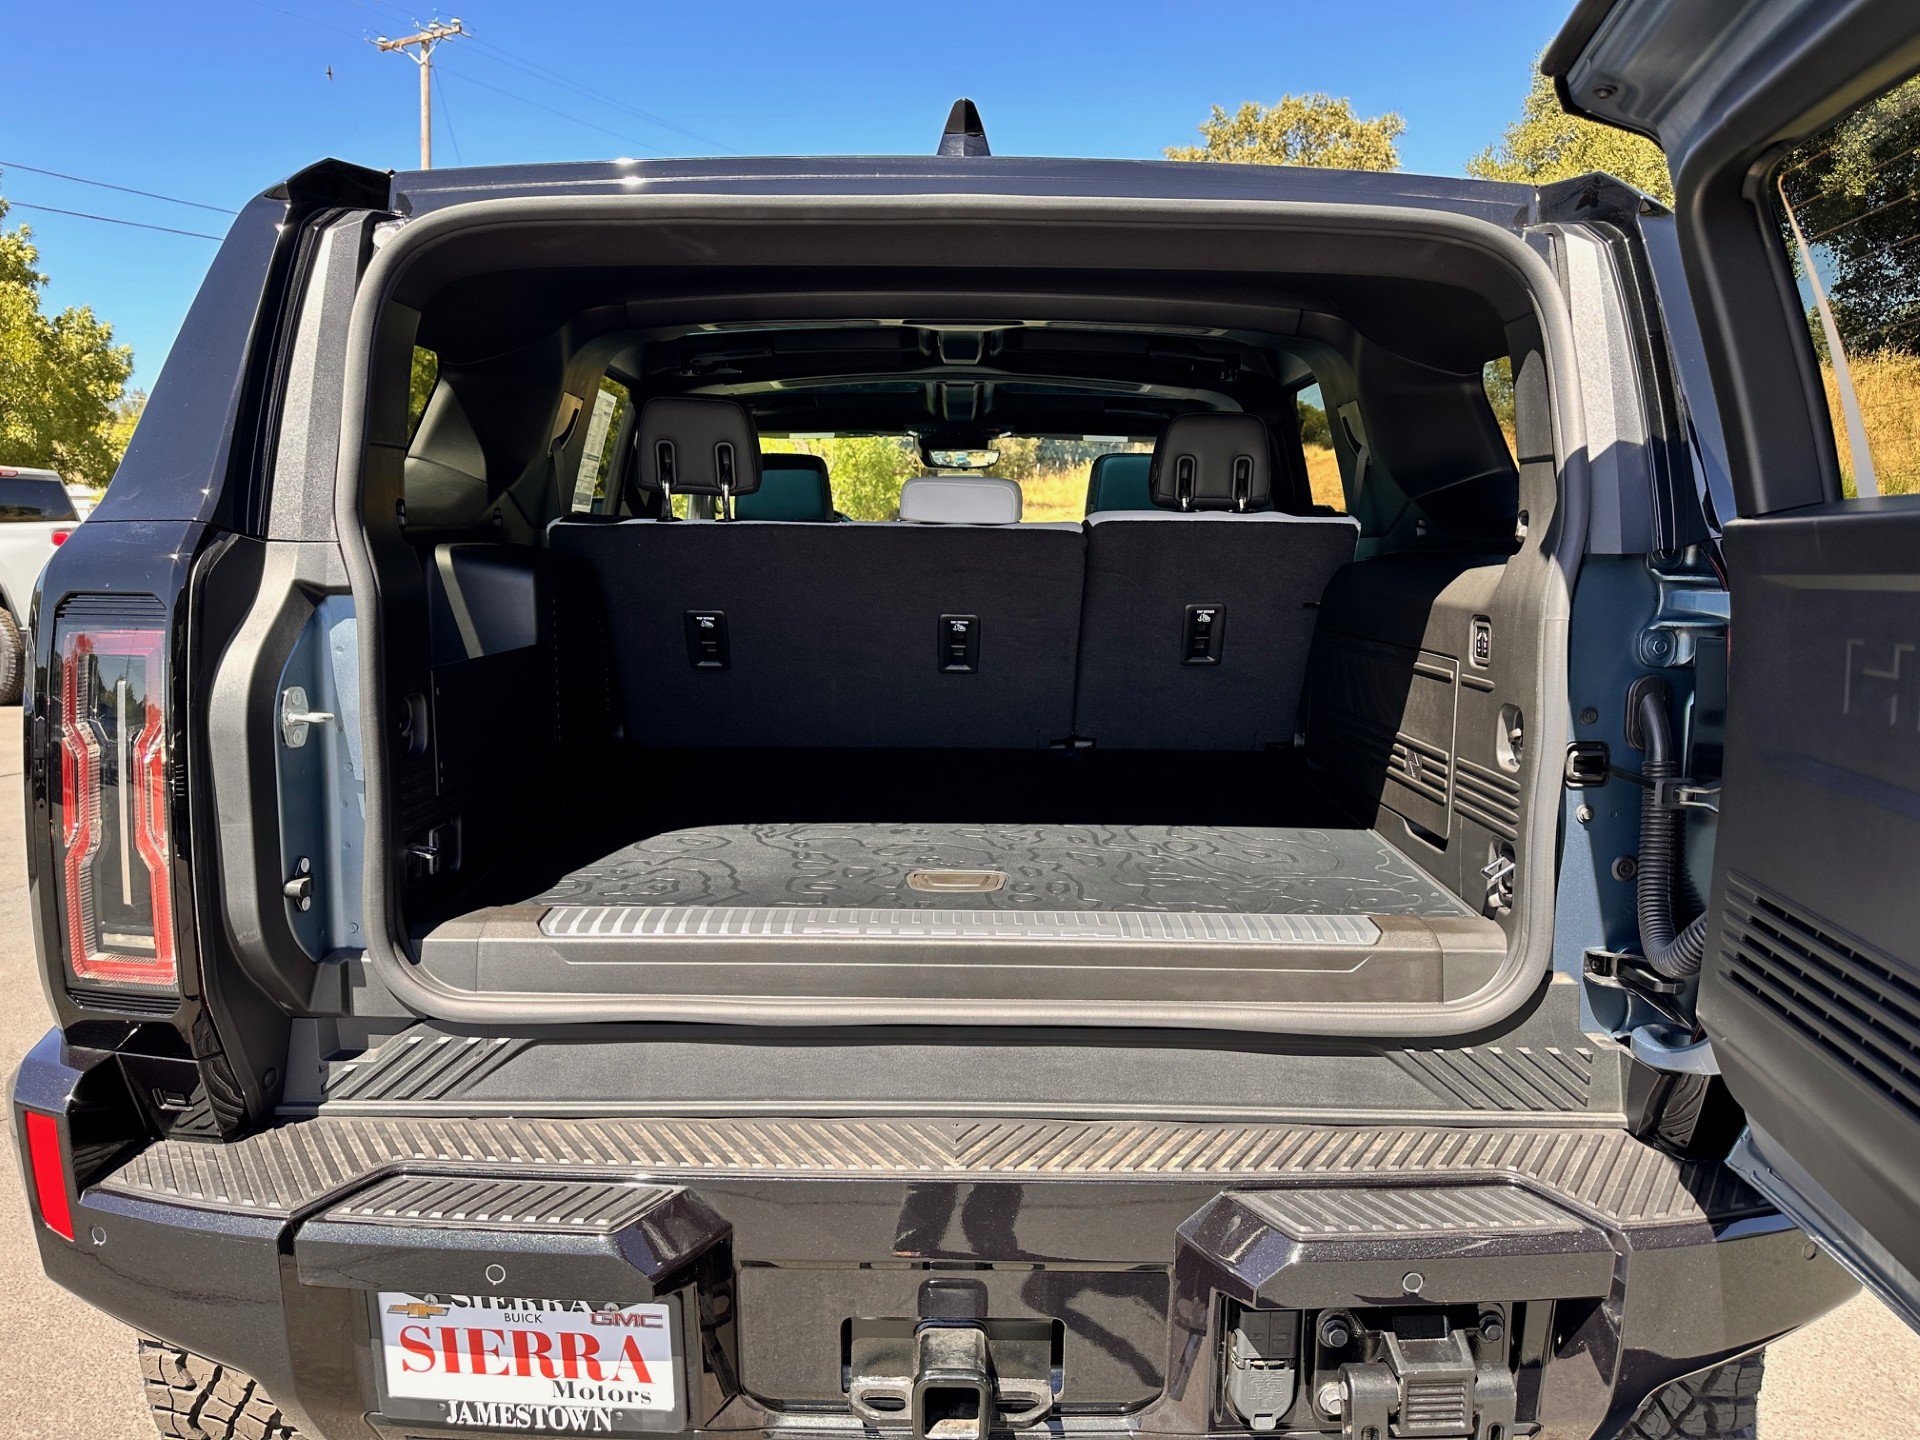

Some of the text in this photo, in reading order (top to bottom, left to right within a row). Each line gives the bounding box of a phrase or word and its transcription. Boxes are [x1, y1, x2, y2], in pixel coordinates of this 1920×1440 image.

[504, 1312, 543, 1324] BUICK
[590, 1311, 663, 1329] GMC
[399, 1325, 657, 1384] SIERRA
[552, 1379, 652, 1405] Motors
[446, 1400, 612, 1432] JAMESTOWN
